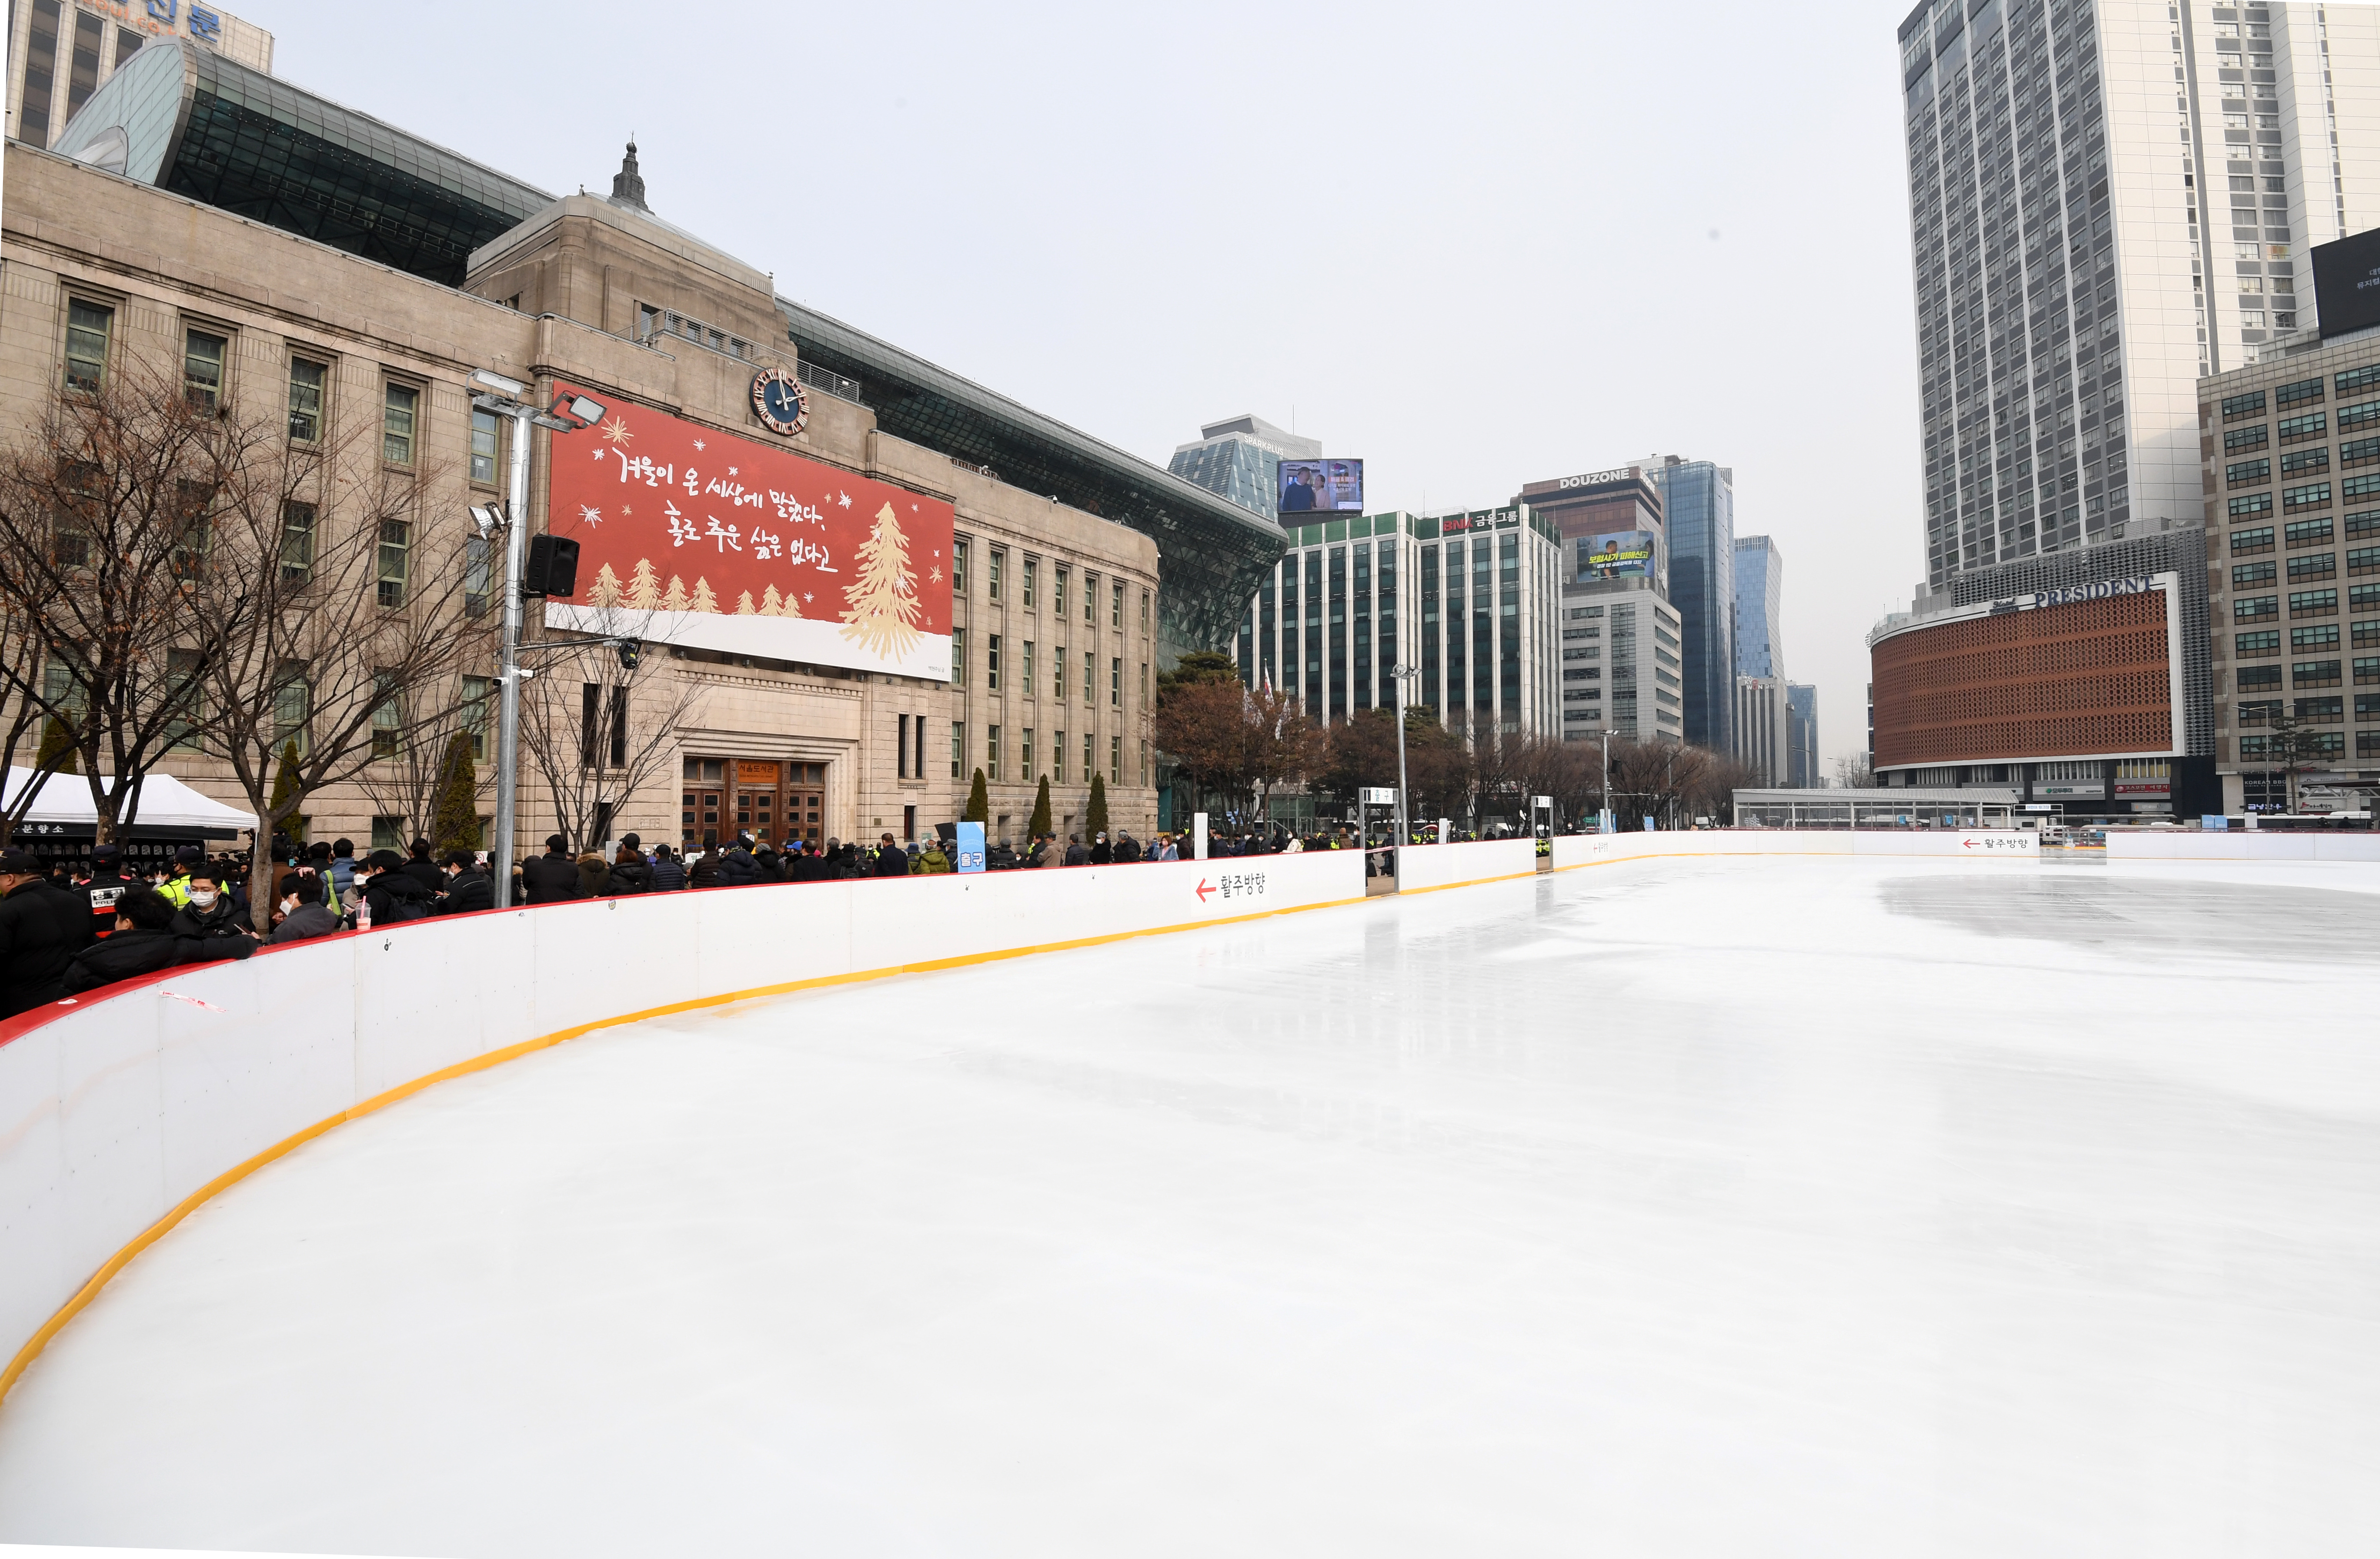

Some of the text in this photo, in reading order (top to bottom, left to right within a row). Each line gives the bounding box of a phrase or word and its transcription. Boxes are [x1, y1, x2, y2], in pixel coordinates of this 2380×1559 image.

[2357, 277, 2380, 290] 뮤지컬
[1244, 436, 1283, 455] SPARKPLUS
[1559, 469, 1629, 489] DOUZONE
[612, 447, 825, 531] 겨울이 온 세상에 말했다,
[1443, 511, 1518, 531] BNK 금융그룹
[664, 500, 838, 573] 홀로 추운 삶은 없다고
[1589, 551, 1649, 564] 보험사기 피해신고
[2034, 575, 2154, 608] PRESIDENT
[739, 764, 774, 773] 서울도서관
[1984, 839, 2028, 848] 활주방향
[960, 852, 983, 867] 출구
[1221, 872, 1265, 898] 활주방향
